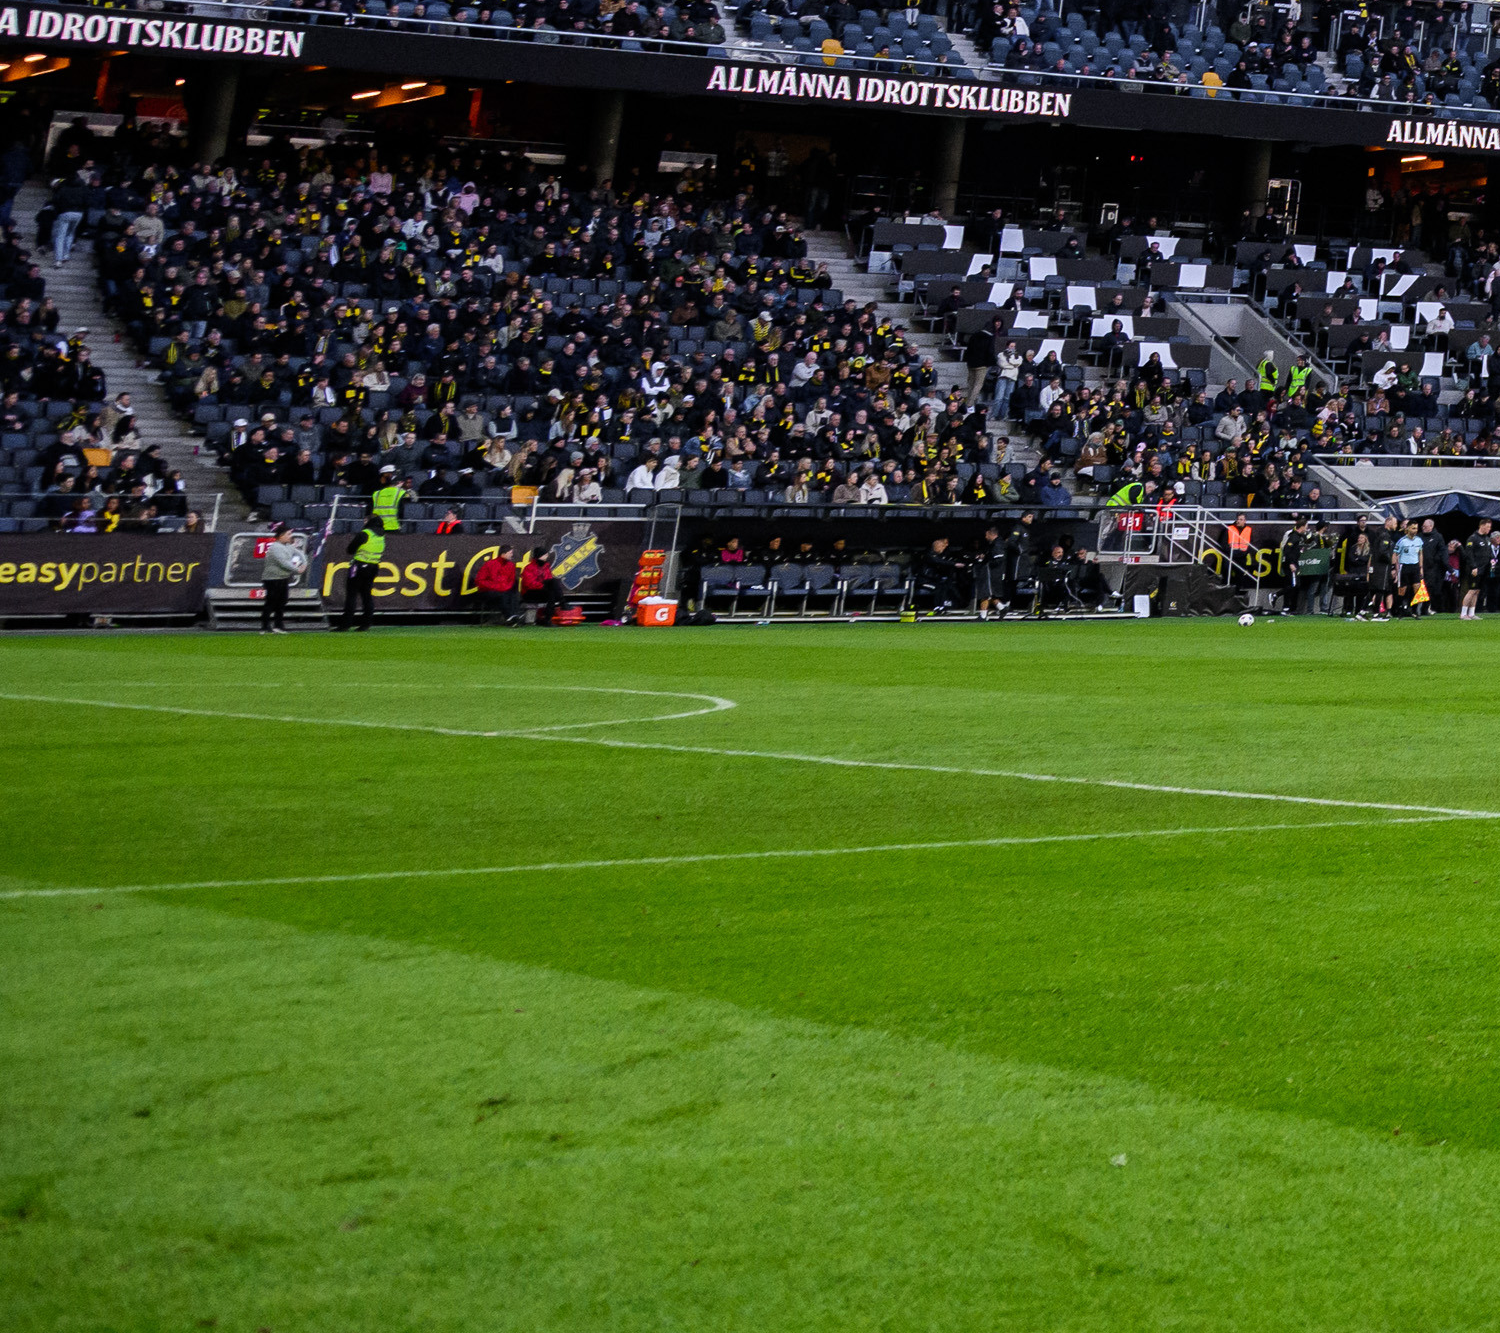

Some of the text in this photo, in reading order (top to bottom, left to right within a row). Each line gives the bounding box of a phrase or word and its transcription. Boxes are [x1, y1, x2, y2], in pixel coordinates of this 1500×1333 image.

[25, 9, 306, 59] IDROTTSKLUBBEN
[706, 65, 1073, 118] ALLMÄNNA IDROTTSKLUBBEN
[0, 554, 201, 593] easypartner
[655, 607, 669, 622] G
